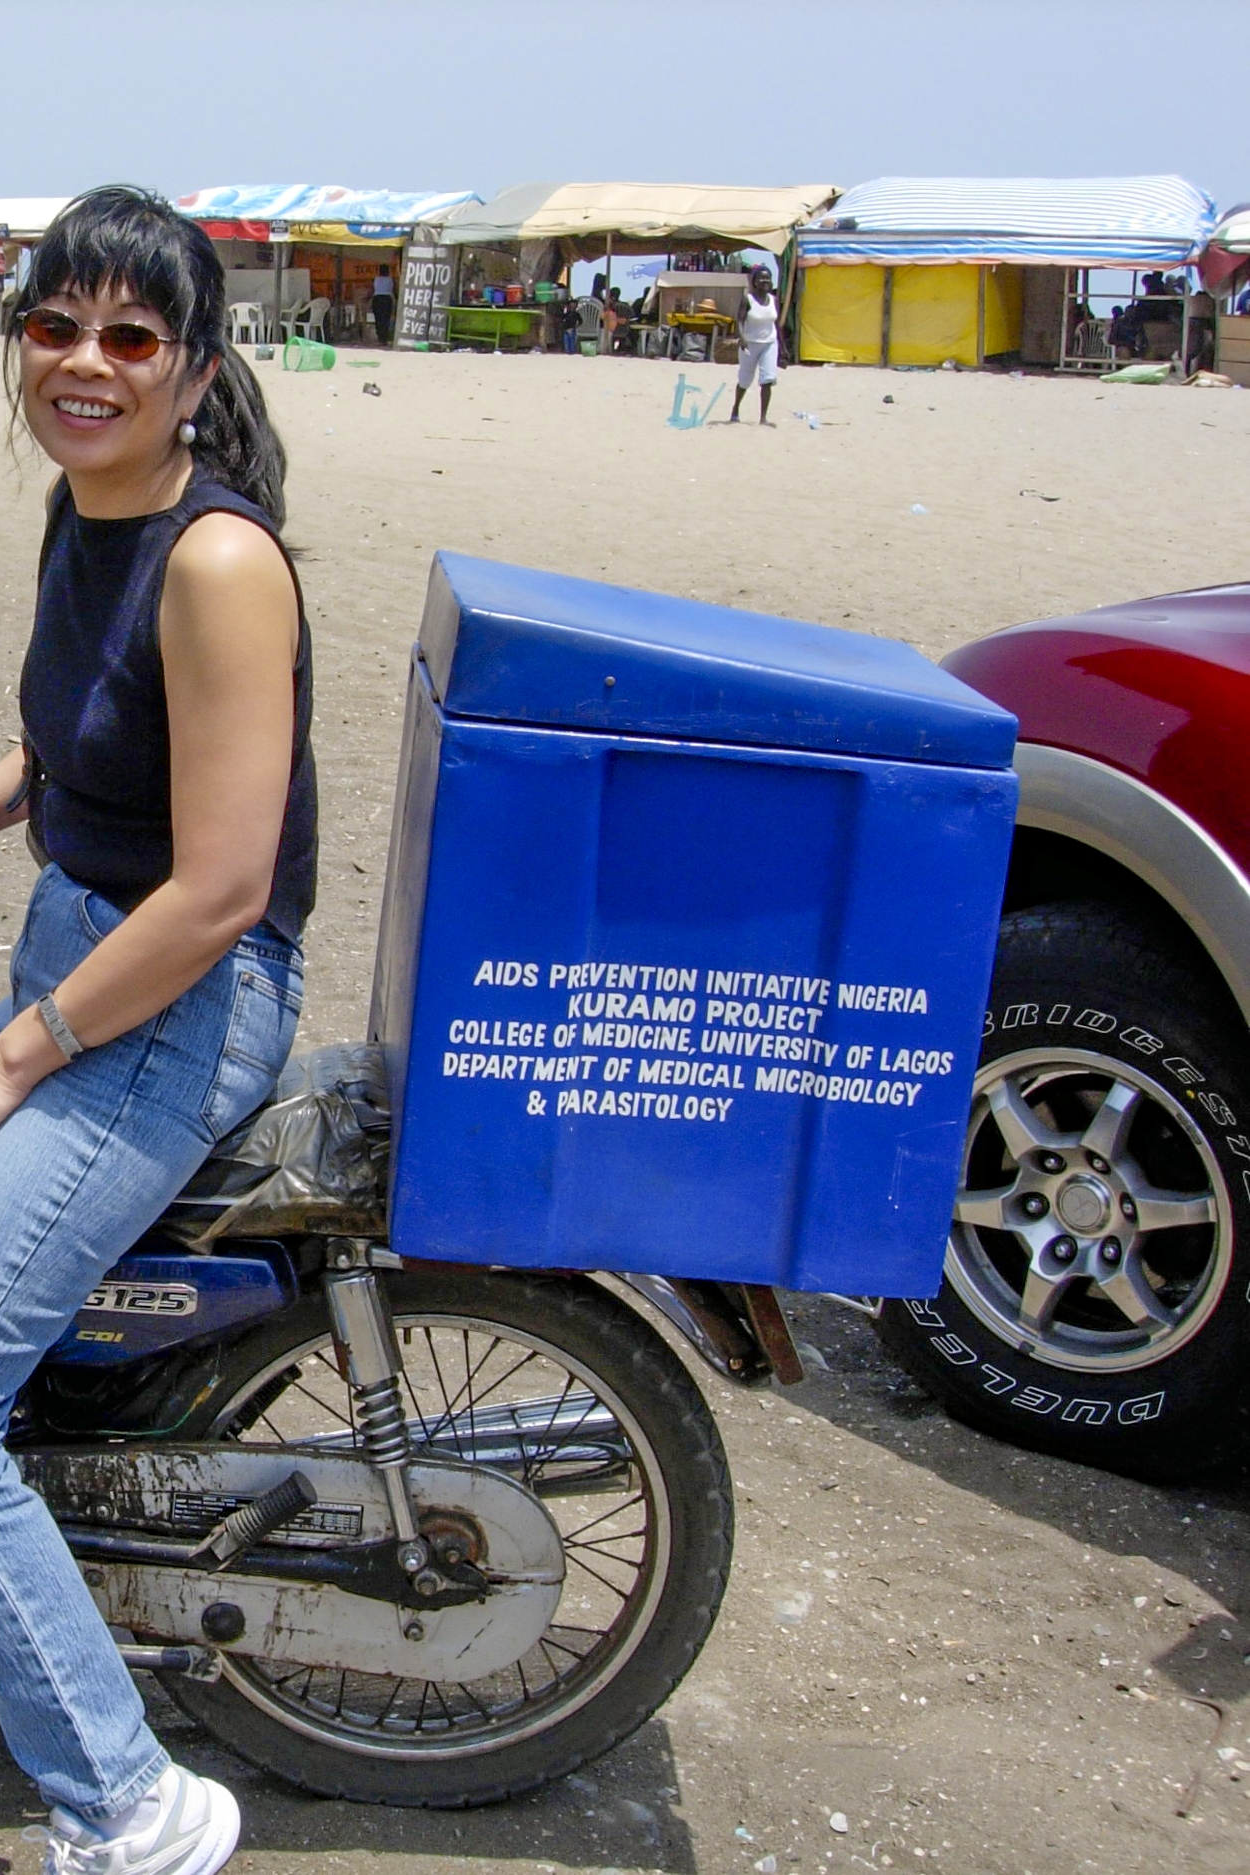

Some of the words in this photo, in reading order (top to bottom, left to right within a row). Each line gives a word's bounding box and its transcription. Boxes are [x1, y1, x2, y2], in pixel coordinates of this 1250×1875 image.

[405, 262, 450, 286] PHOTO
[402, 307, 417, 318] FOR
[403, 288, 442, 307] HERE
[474, 961, 539, 987] AIDS
[550, 963, 698, 990] PREVENTION
[706, 970, 831, 1005] INITIATIVE
[838, 984, 928, 1014] NIGERIA
[568, 993, 696, 1022] KURAMO
[707, 1000, 823, 1034] PROJECT
[449, 1020, 547, 1047] COLLEGE
[553, 1024, 577, 1048] OF
[582, 1022, 698, 1056] MEDICINE,
[701, 1029, 839, 1067] UNIVERSITY
[846, 1045, 874, 1069] OF
[880, 1047, 954, 1075] LAGOS
[443, 1052, 599, 1082] DEPARTMENT
[603, 1057, 633, 1082] OF
[638, 1058, 745, 1089] MEDICAL
[755, 1066, 923, 1106] MICROBIOLOGY
[526, 1090, 547, 1116] &
[557, 1089, 734, 1122] PARASITOLOGY
